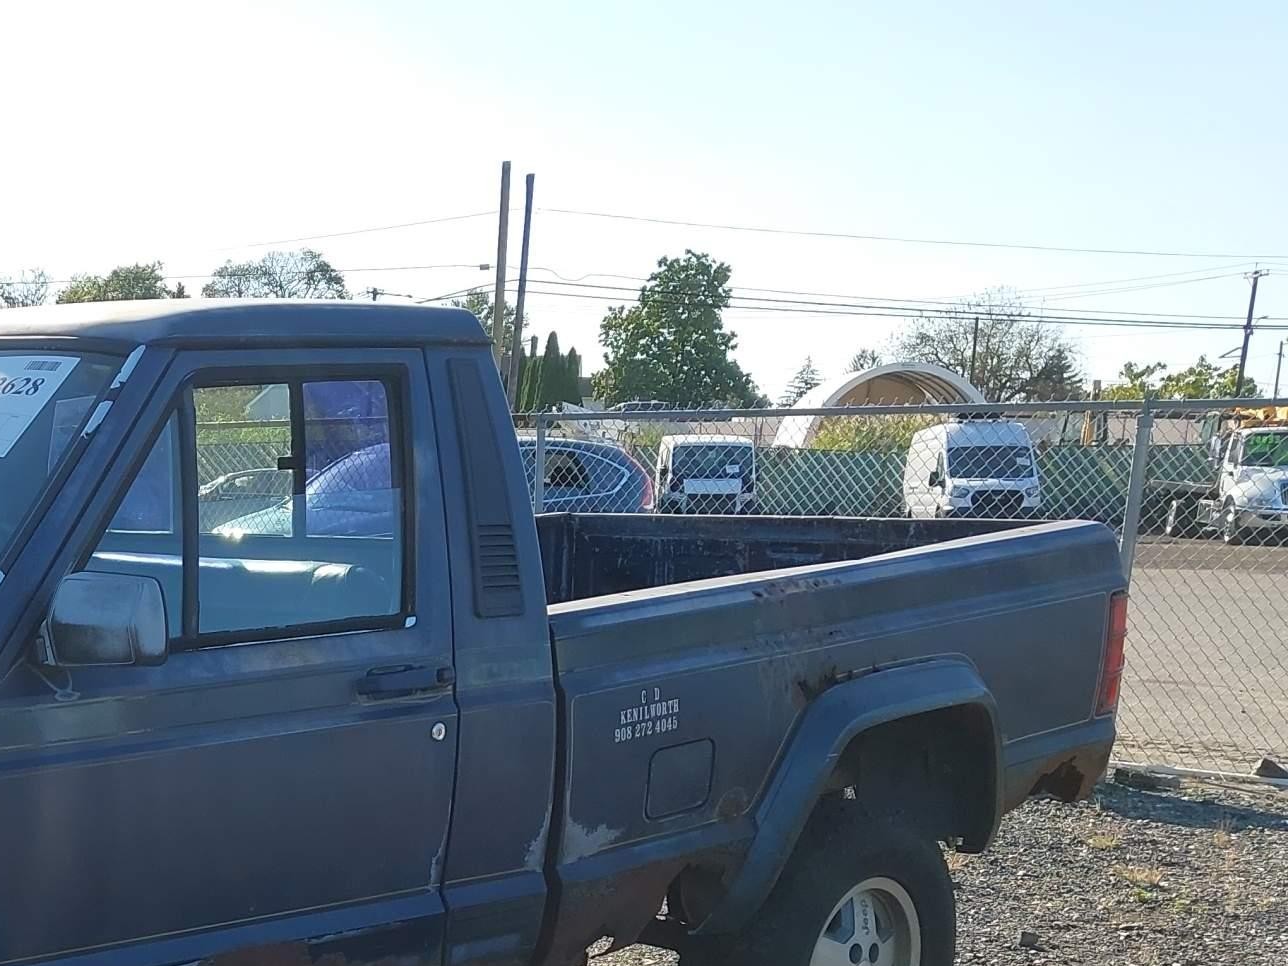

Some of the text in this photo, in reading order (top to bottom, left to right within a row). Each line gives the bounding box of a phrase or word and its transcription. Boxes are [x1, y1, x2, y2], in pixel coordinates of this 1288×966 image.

[641, 687, 660, 704] C D
[620, 698, 679, 725] KENILWORTH
[614, 726, 632, 743] 908
[635, 721, 653, 738] 272
